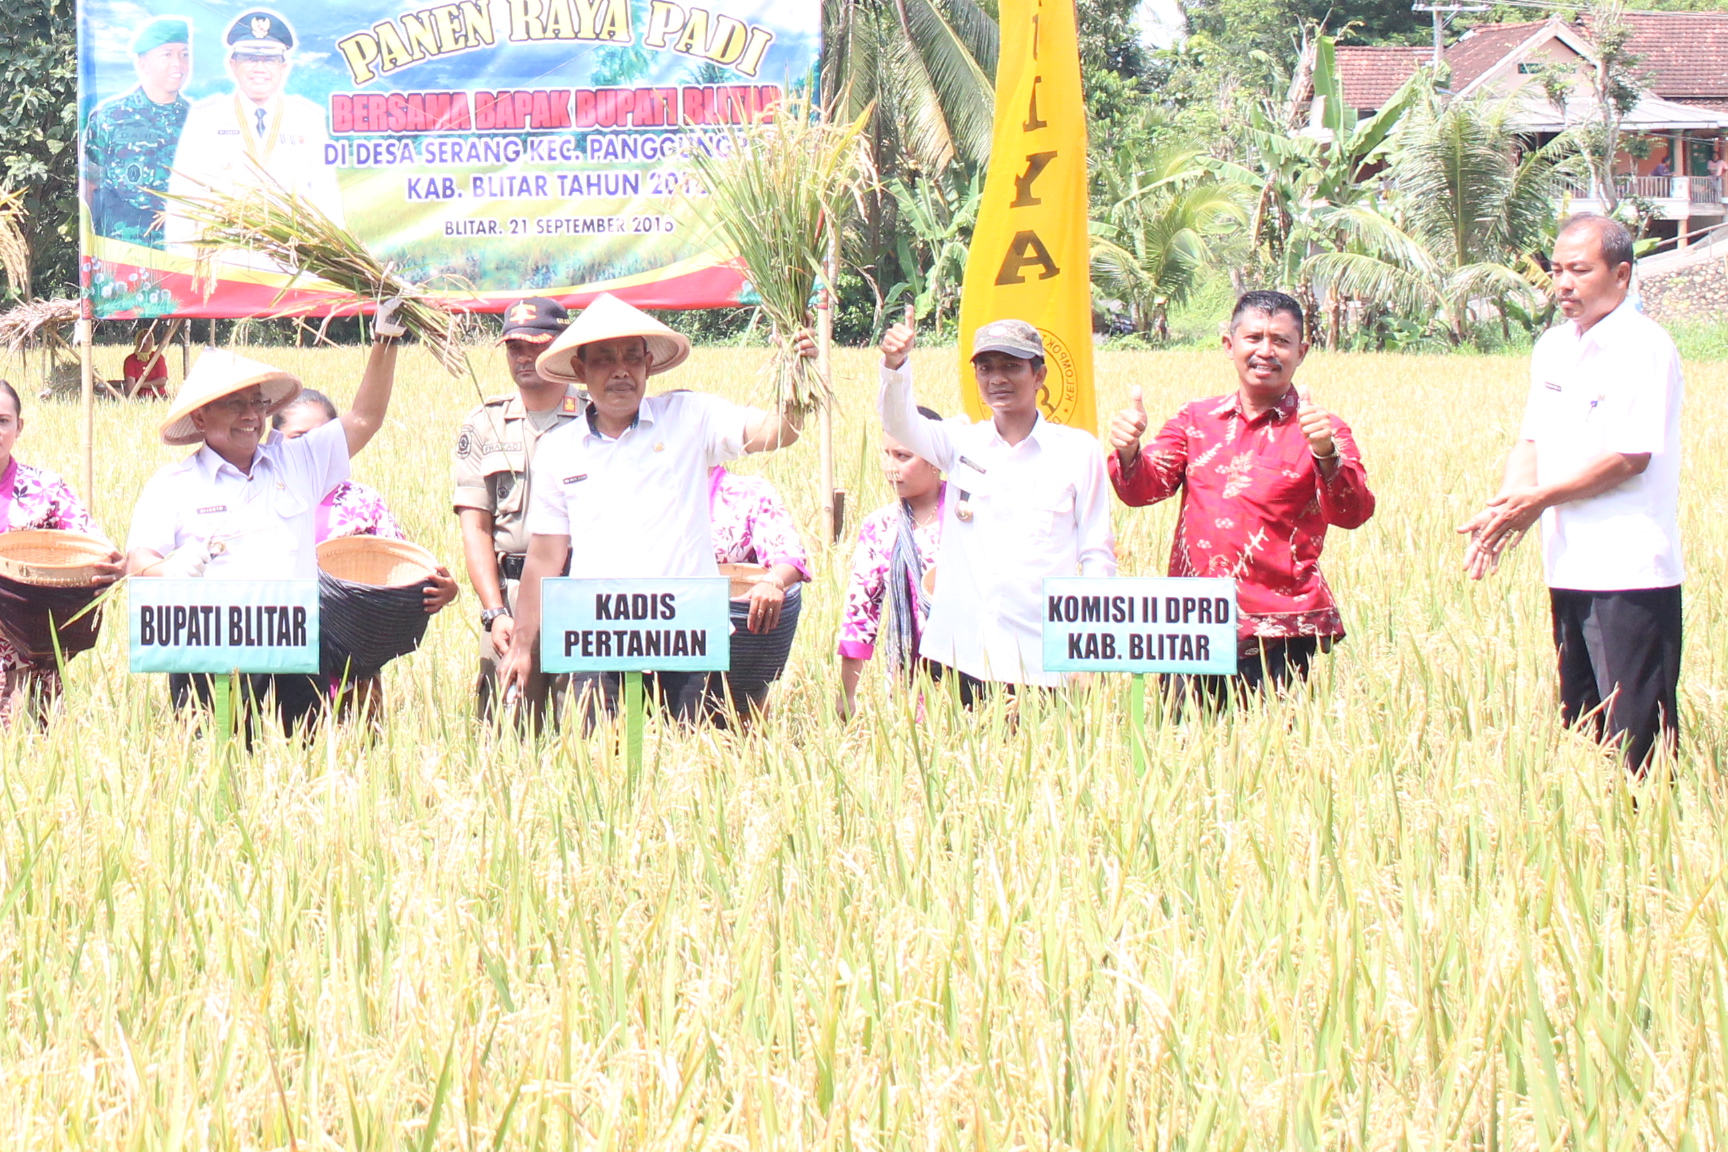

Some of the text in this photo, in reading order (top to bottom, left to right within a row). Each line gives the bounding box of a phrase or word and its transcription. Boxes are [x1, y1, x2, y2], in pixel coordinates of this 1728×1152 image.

[644, 0, 772, 77] PADI
[332, 92, 471, 133] BERSAMA
[475, 90, 571, 130] BAPAK
[575, 86, 677, 128] BUPATI
[324, 143, 346, 165] DI
[356, 142, 414, 165] DESA
[425, 140, 521, 163] SERANG
[407, 177, 462, 199] KAB.
[473, 175, 548, 198] BLITAR
[557, 173, 639, 196] TAHUN
[509, 219, 527, 234] 21
[537, 217, 625, 234] SEPTEMBER
[595, 593, 676, 620] KADIS
[1048, 595, 1229, 624] KOMISI II DPRD
[140, 605, 307, 647] BUPATI BLITAR
[564, 629, 707, 657] PERTANIAN
[1068, 633, 1210, 661] KAB. BLITAR
